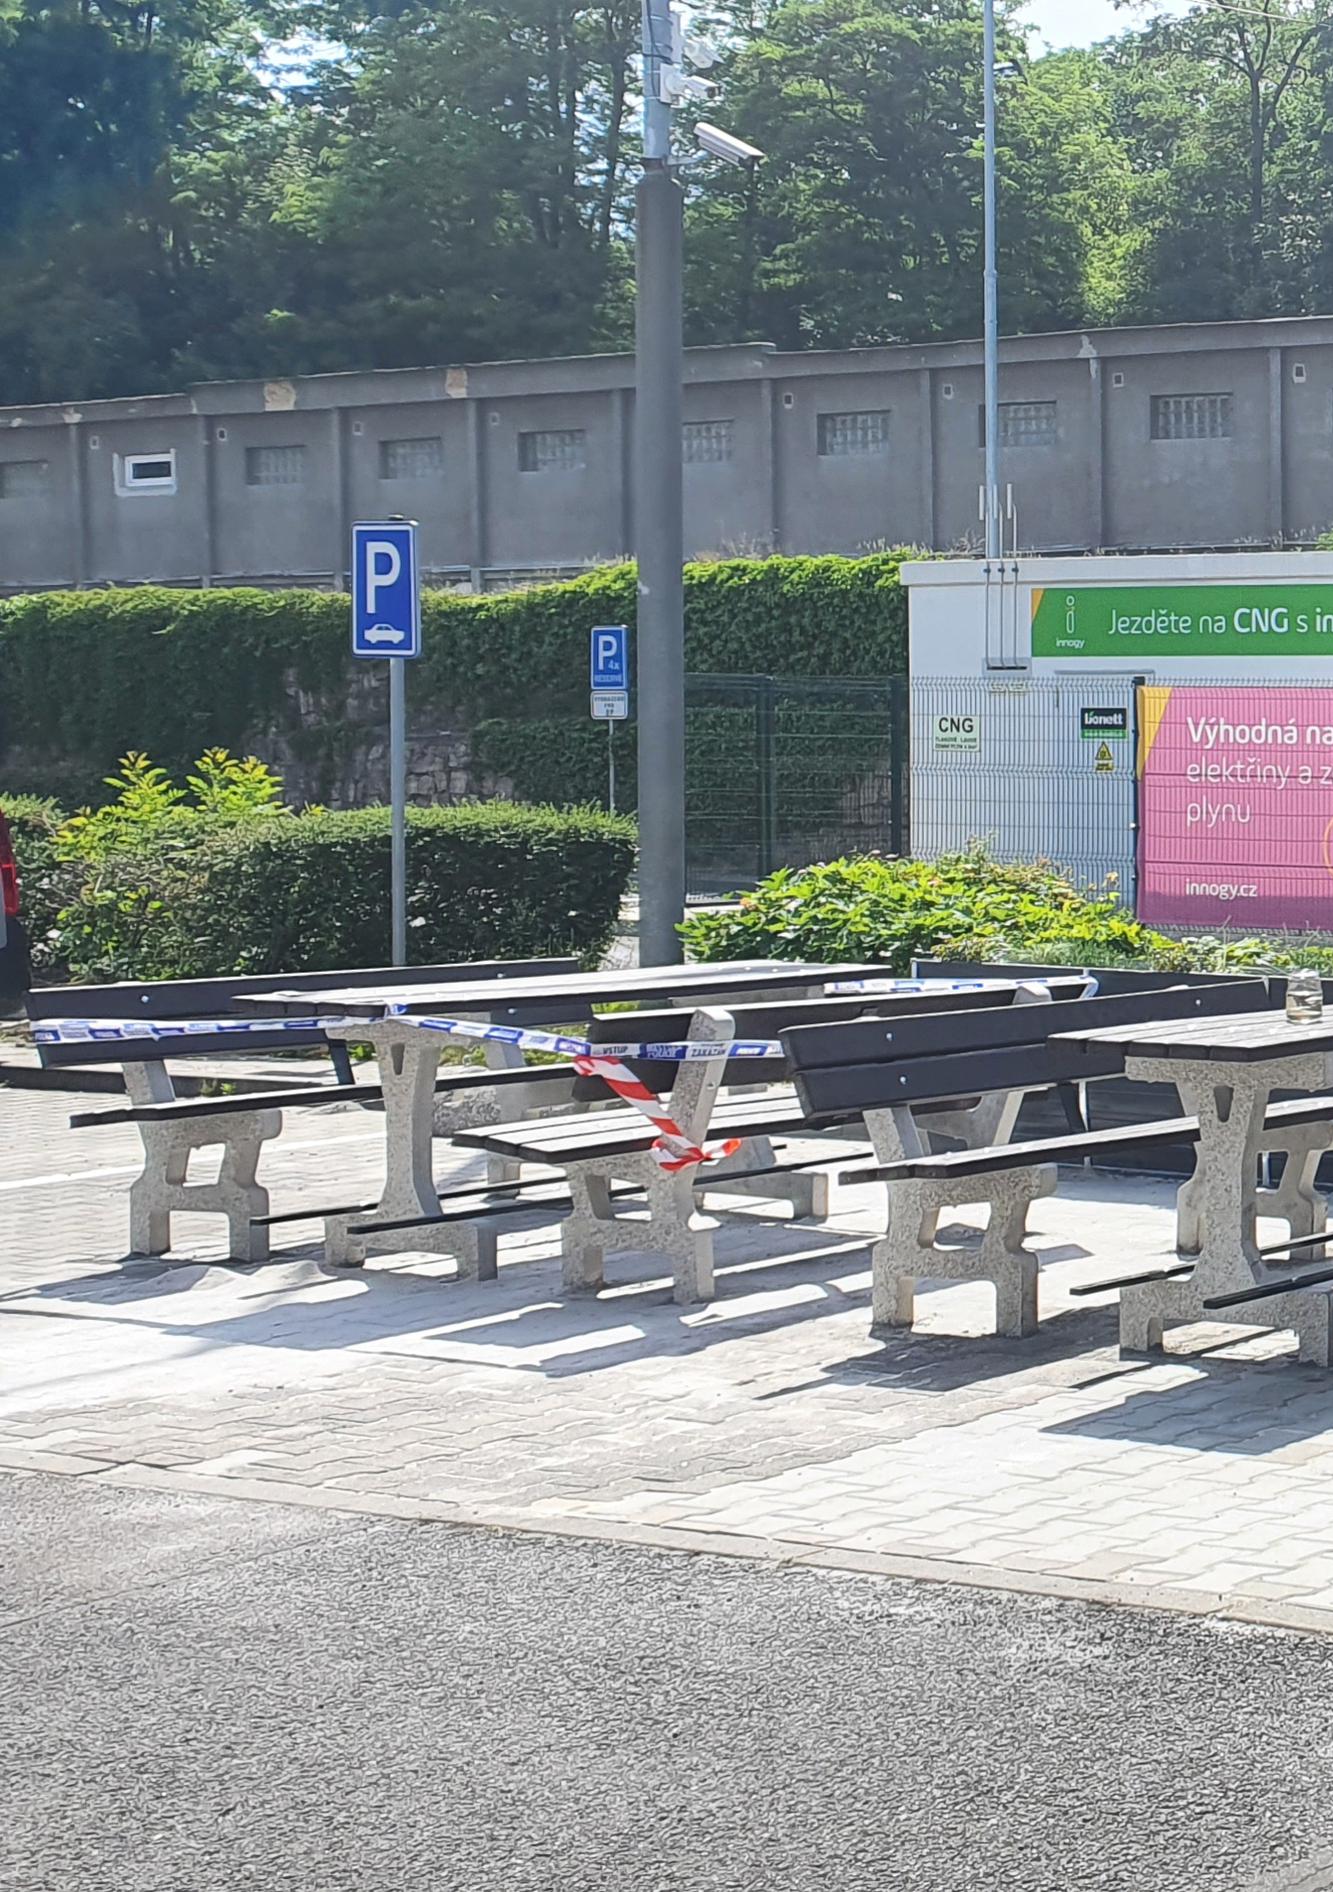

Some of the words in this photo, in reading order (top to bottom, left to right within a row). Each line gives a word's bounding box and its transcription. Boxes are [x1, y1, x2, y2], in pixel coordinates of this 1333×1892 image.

[366, 541, 401, 614] P
[1108, 608, 1192, 635] Jezděte
[1199, 615, 1227, 634] na
[1233, 607, 1289, 633] CNG
[1296, 614, 1309, 633] s
[598, 635, 618, 671] P
[1055, 637, 1085, 649] innogy
[938, 716, 974, 733] CNG
[1084, 711, 1123, 725] bonett
[1186, 716, 1298, 749] Výhodná
[1186, 756, 1291, 790] elektřiny
[1298, 765, 1312, 784] a
[1187, 795, 1251, 828] plynu
[1185, 877, 1258, 900] innogy.cz
